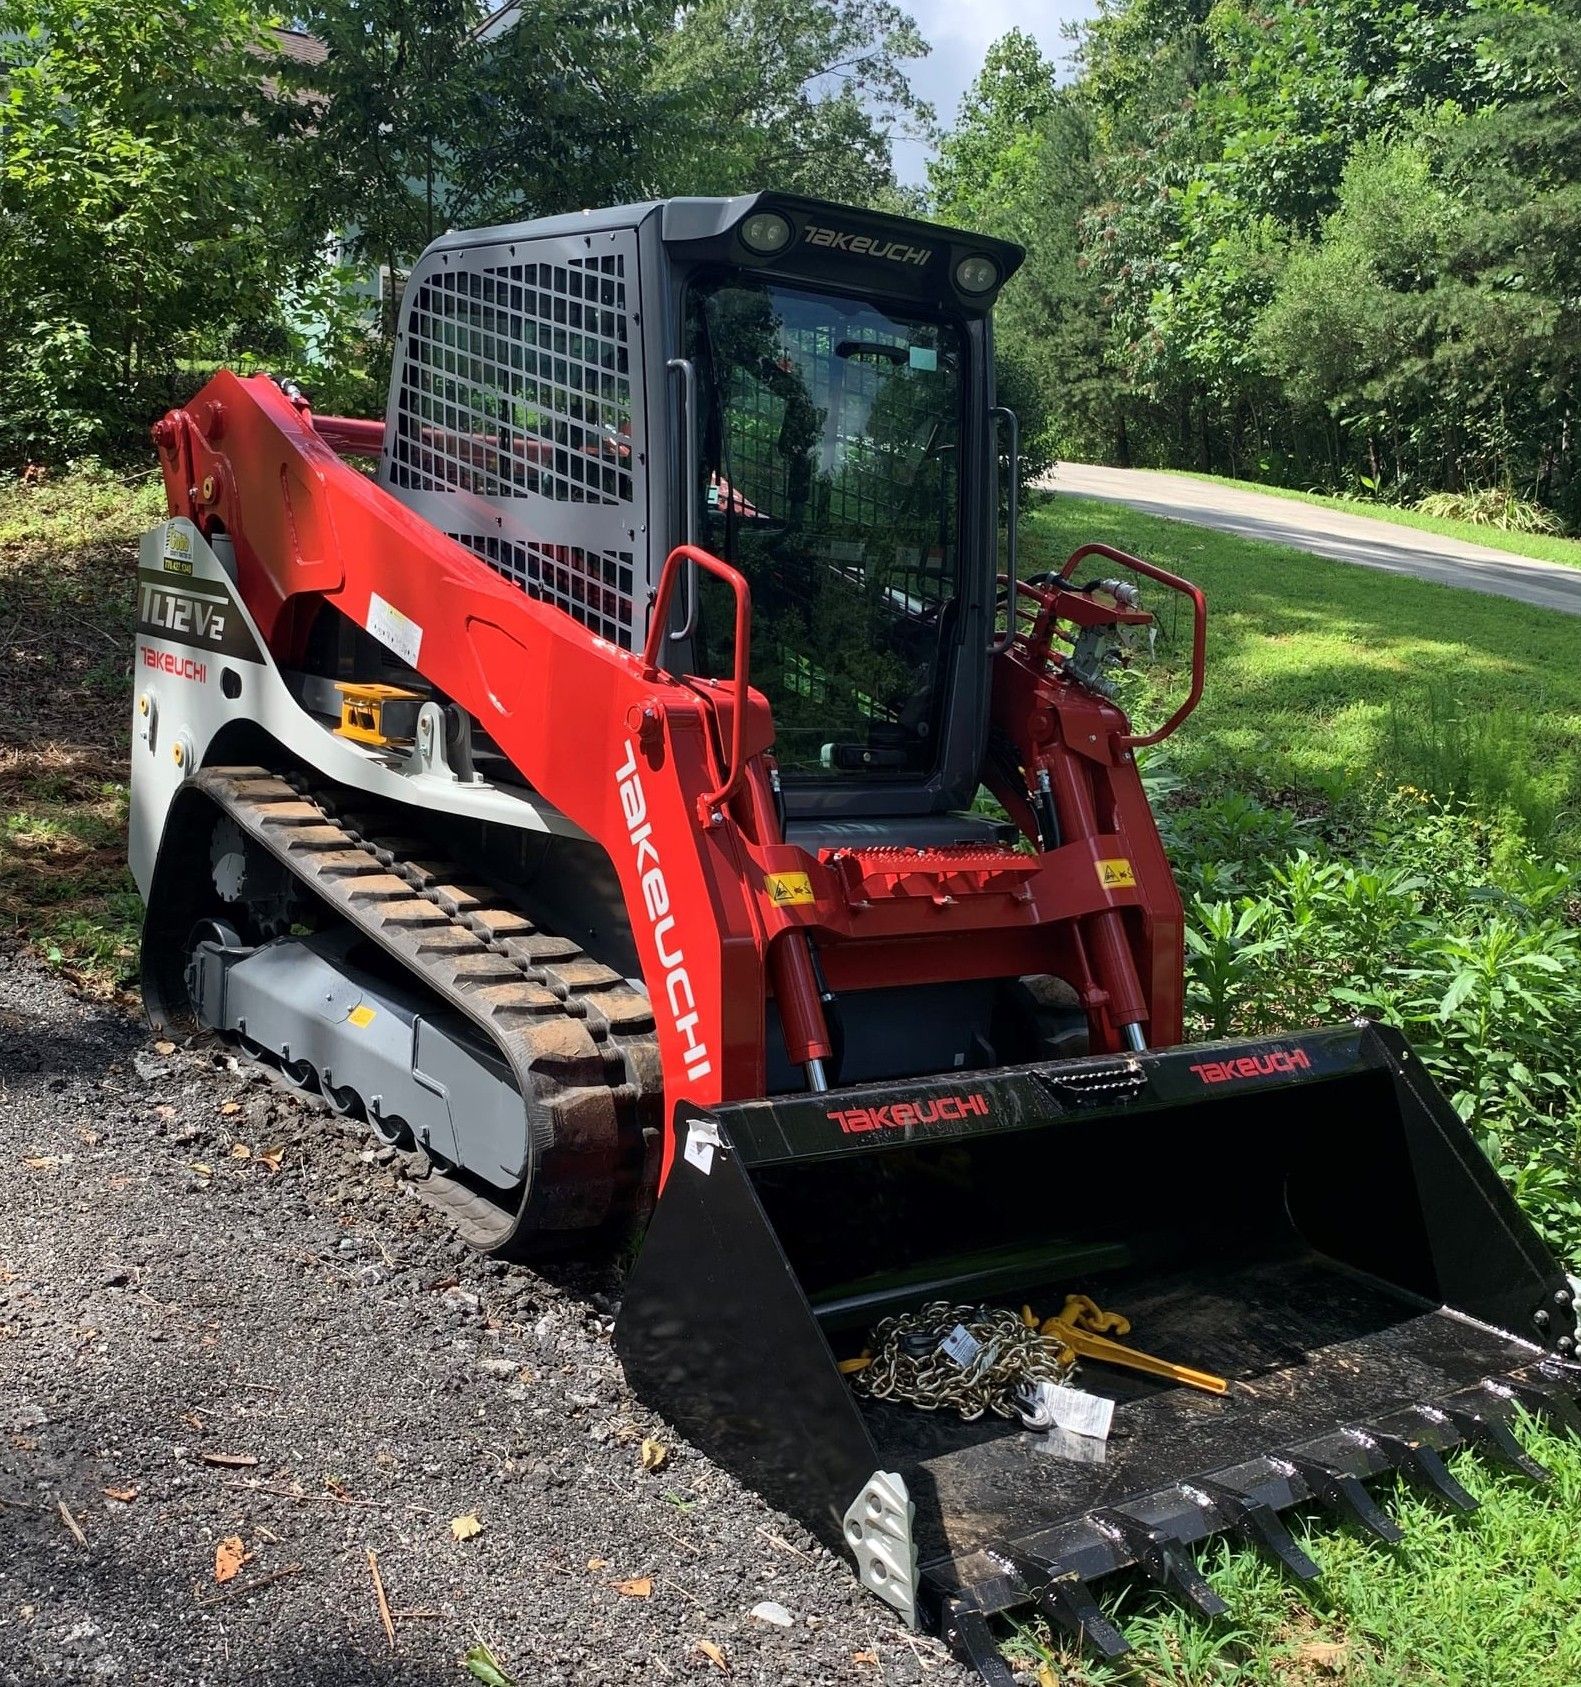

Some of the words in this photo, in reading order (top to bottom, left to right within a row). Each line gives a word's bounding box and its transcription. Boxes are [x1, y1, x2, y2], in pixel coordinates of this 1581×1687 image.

[803, 225, 933, 266] TAKEUCHI
[141, 581, 229, 641] TL12V2
[140, 646, 207, 684] TAKEUCHI
[615, 739, 712, 1082] TAKEUCHI
[1190, 1049, 1311, 1084] TAKEUCHI
[826, 1093, 989, 1134] TAKEUCHI
